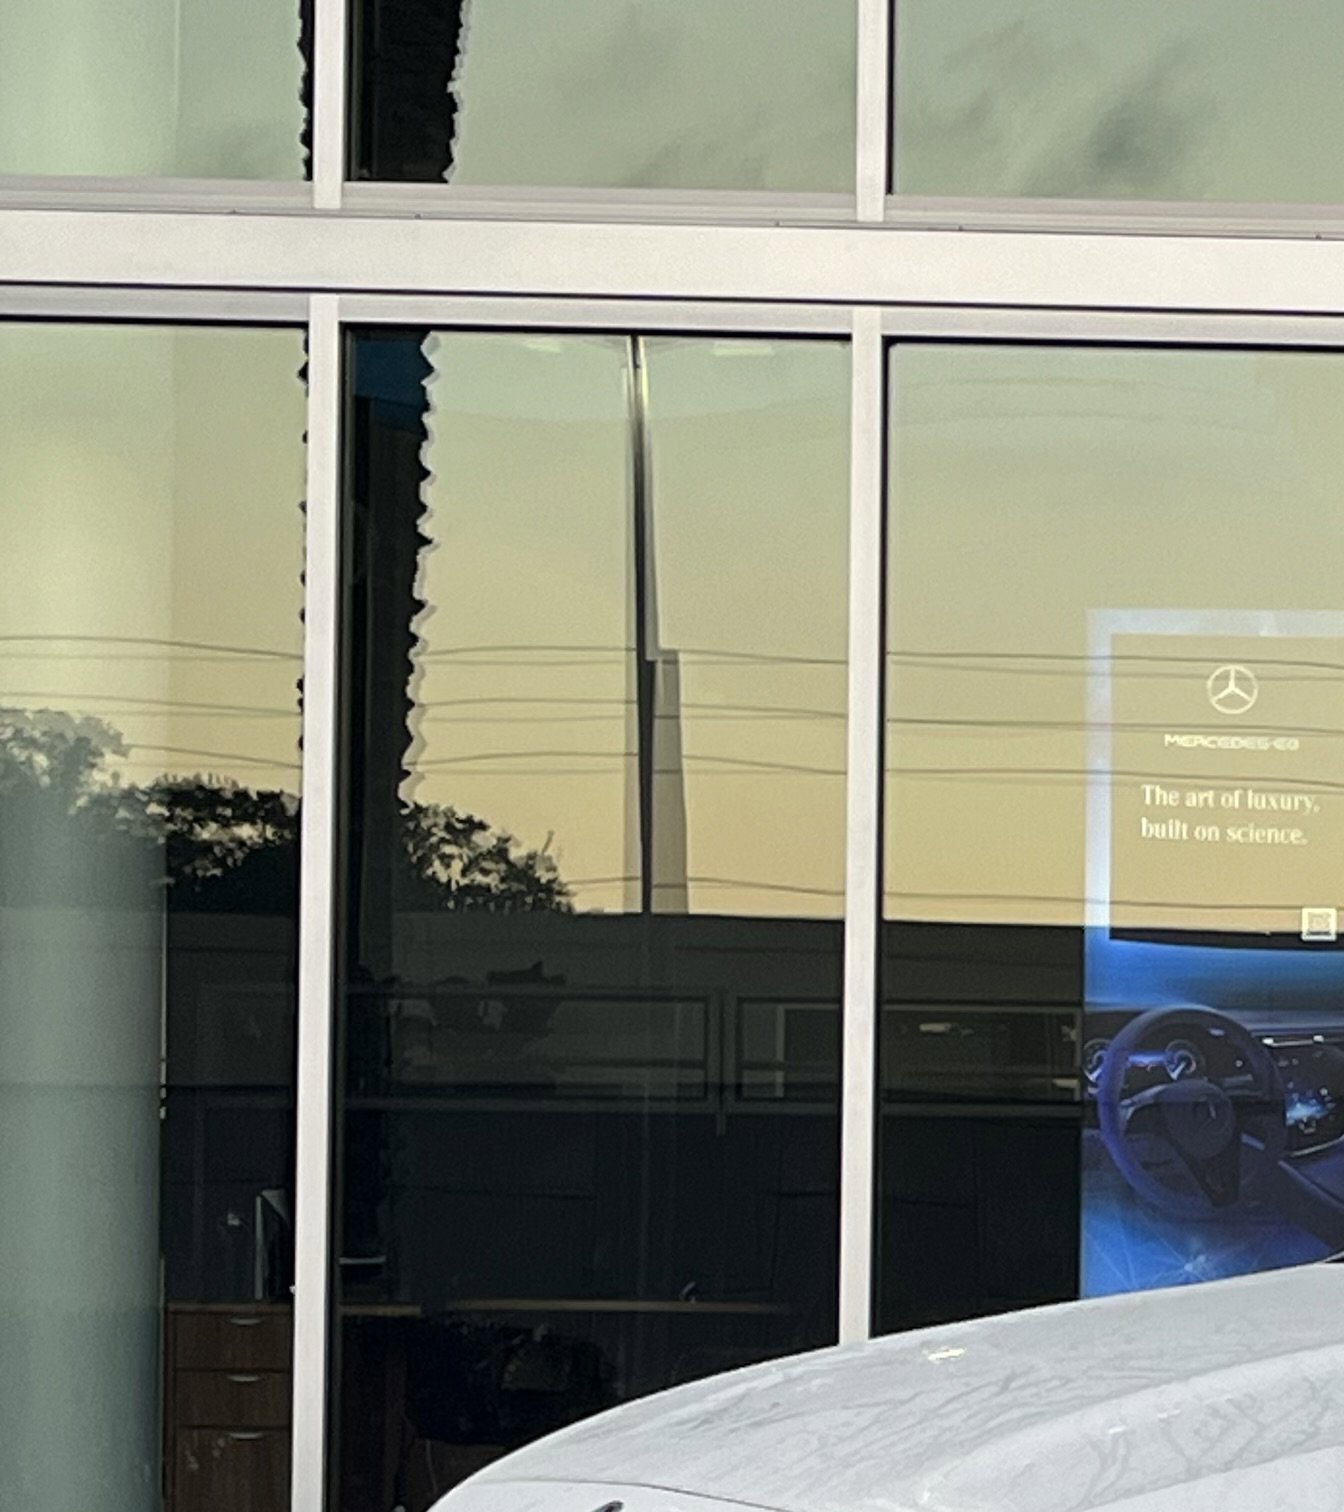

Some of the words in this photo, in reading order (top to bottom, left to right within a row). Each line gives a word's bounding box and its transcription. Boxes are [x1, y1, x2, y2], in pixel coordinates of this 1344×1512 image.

[1141, 784, 1180, 806] The
[1185, 787, 1214, 809] art
[1220, 788, 1244, 809] of
[1141, 817, 1189, 840] built
[1194, 825, 1220, 842] on
[1226, 823, 1308, 845] science.
